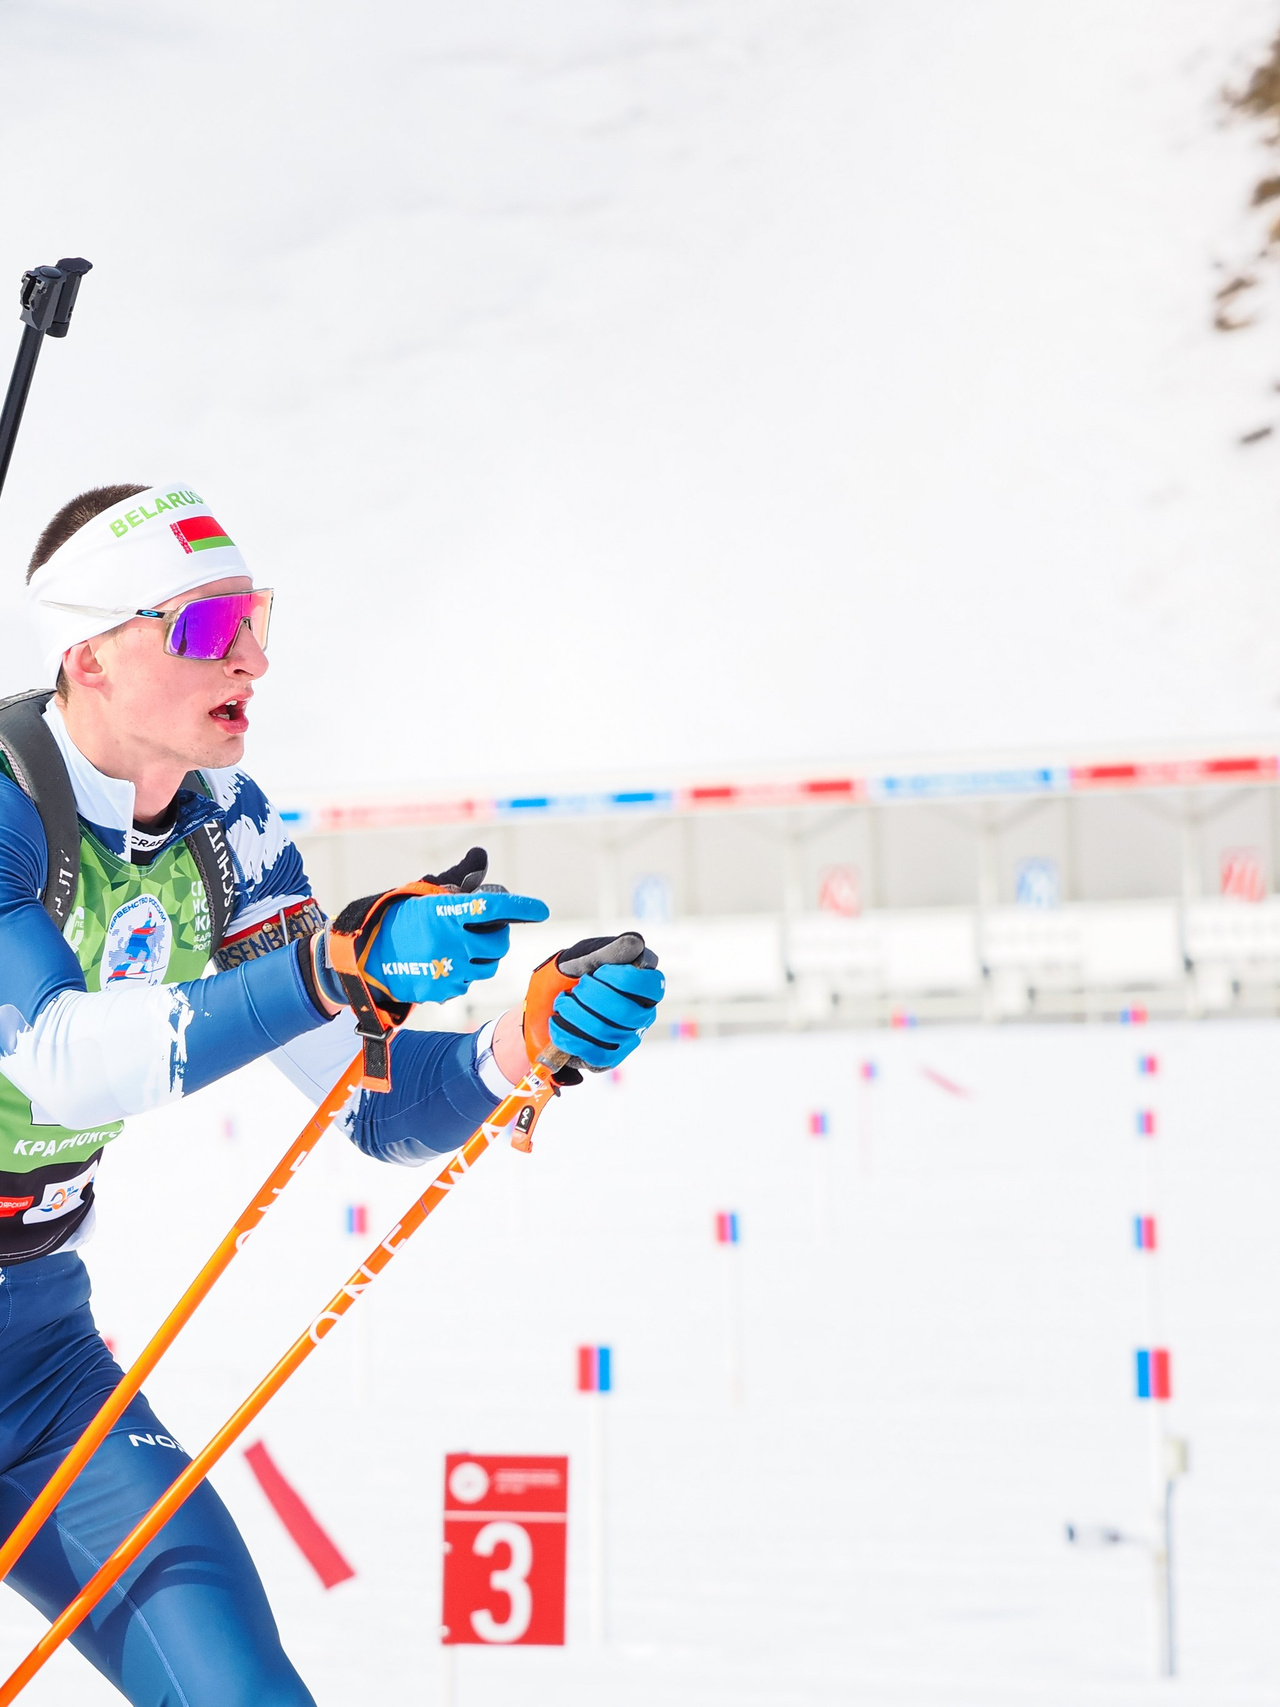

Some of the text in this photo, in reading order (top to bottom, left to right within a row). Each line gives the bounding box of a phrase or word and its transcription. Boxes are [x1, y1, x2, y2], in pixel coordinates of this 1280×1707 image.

[109, 490, 204, 538] BELARUS
[131, 836, 166, 848] CRAF
[436, 898, 487, 916] KINETIXX
[382, 957, 454, 980] KINETIXX
[471, 1521, 533, 1644] 3
